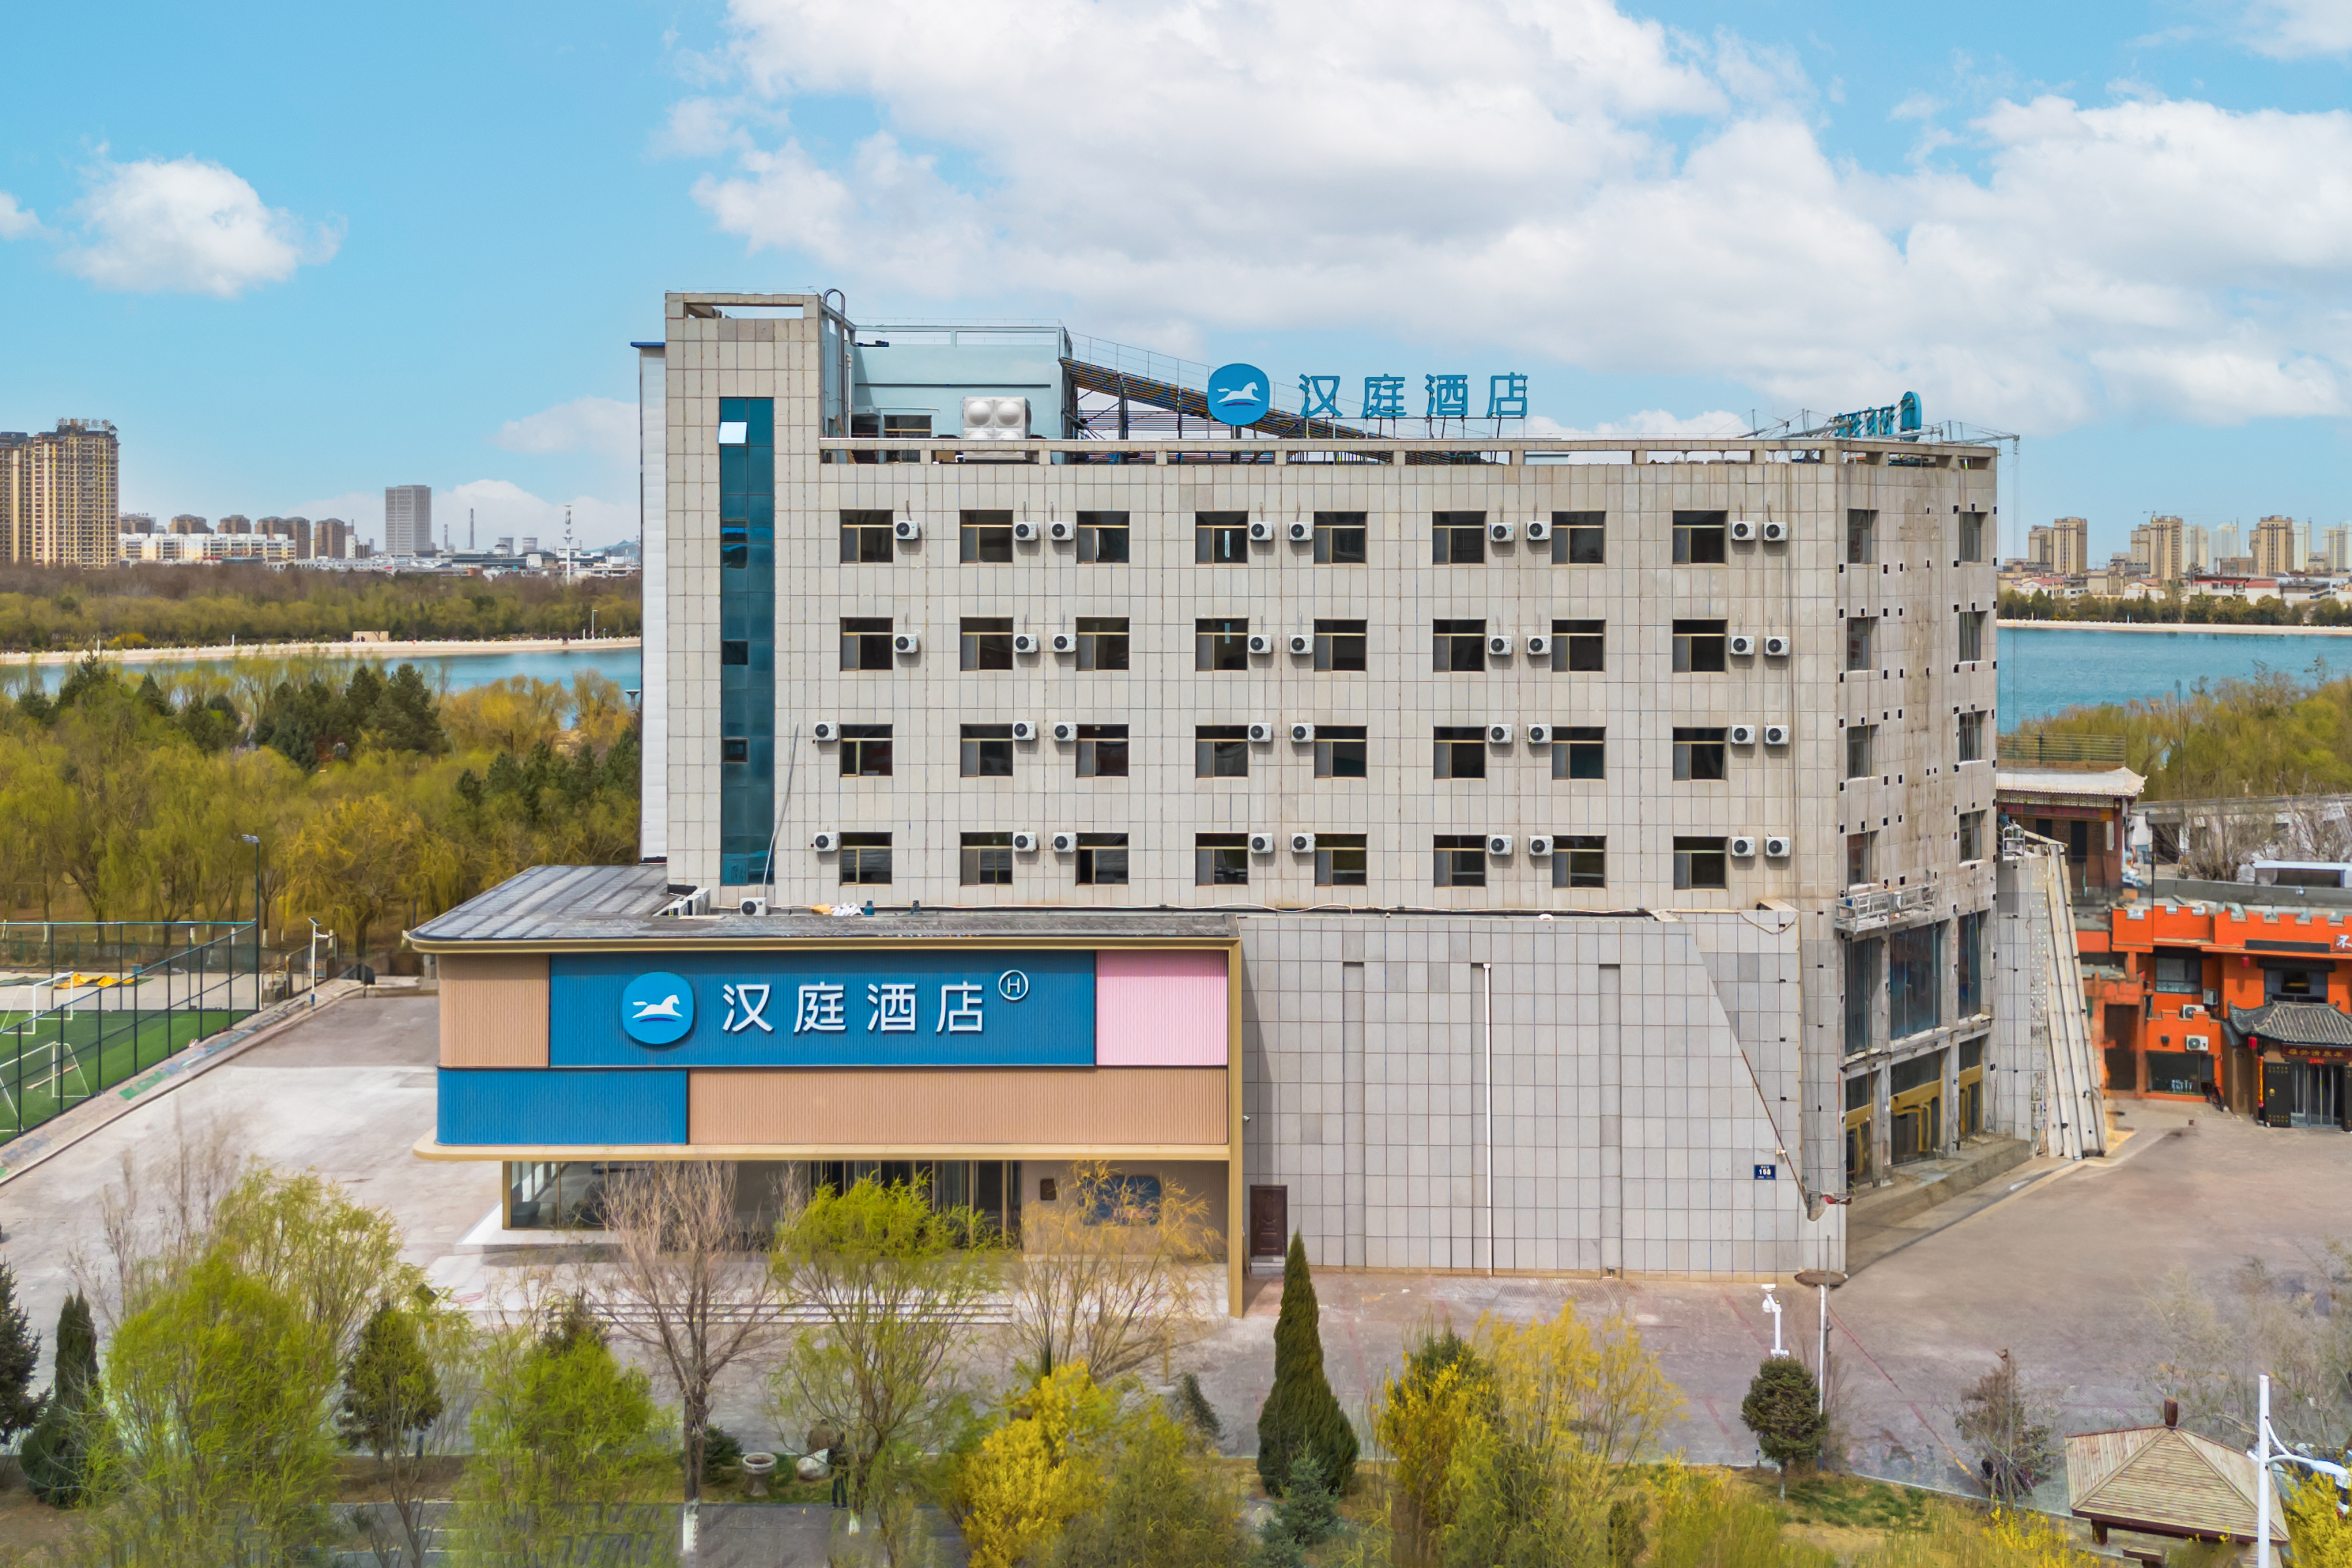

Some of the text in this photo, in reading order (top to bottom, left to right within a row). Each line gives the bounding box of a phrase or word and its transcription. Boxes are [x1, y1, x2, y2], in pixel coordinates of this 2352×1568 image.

[1299, 372, 1528, 418] 汉庭酒店
[722, 981, 983, 1032] 汉庭酒店
